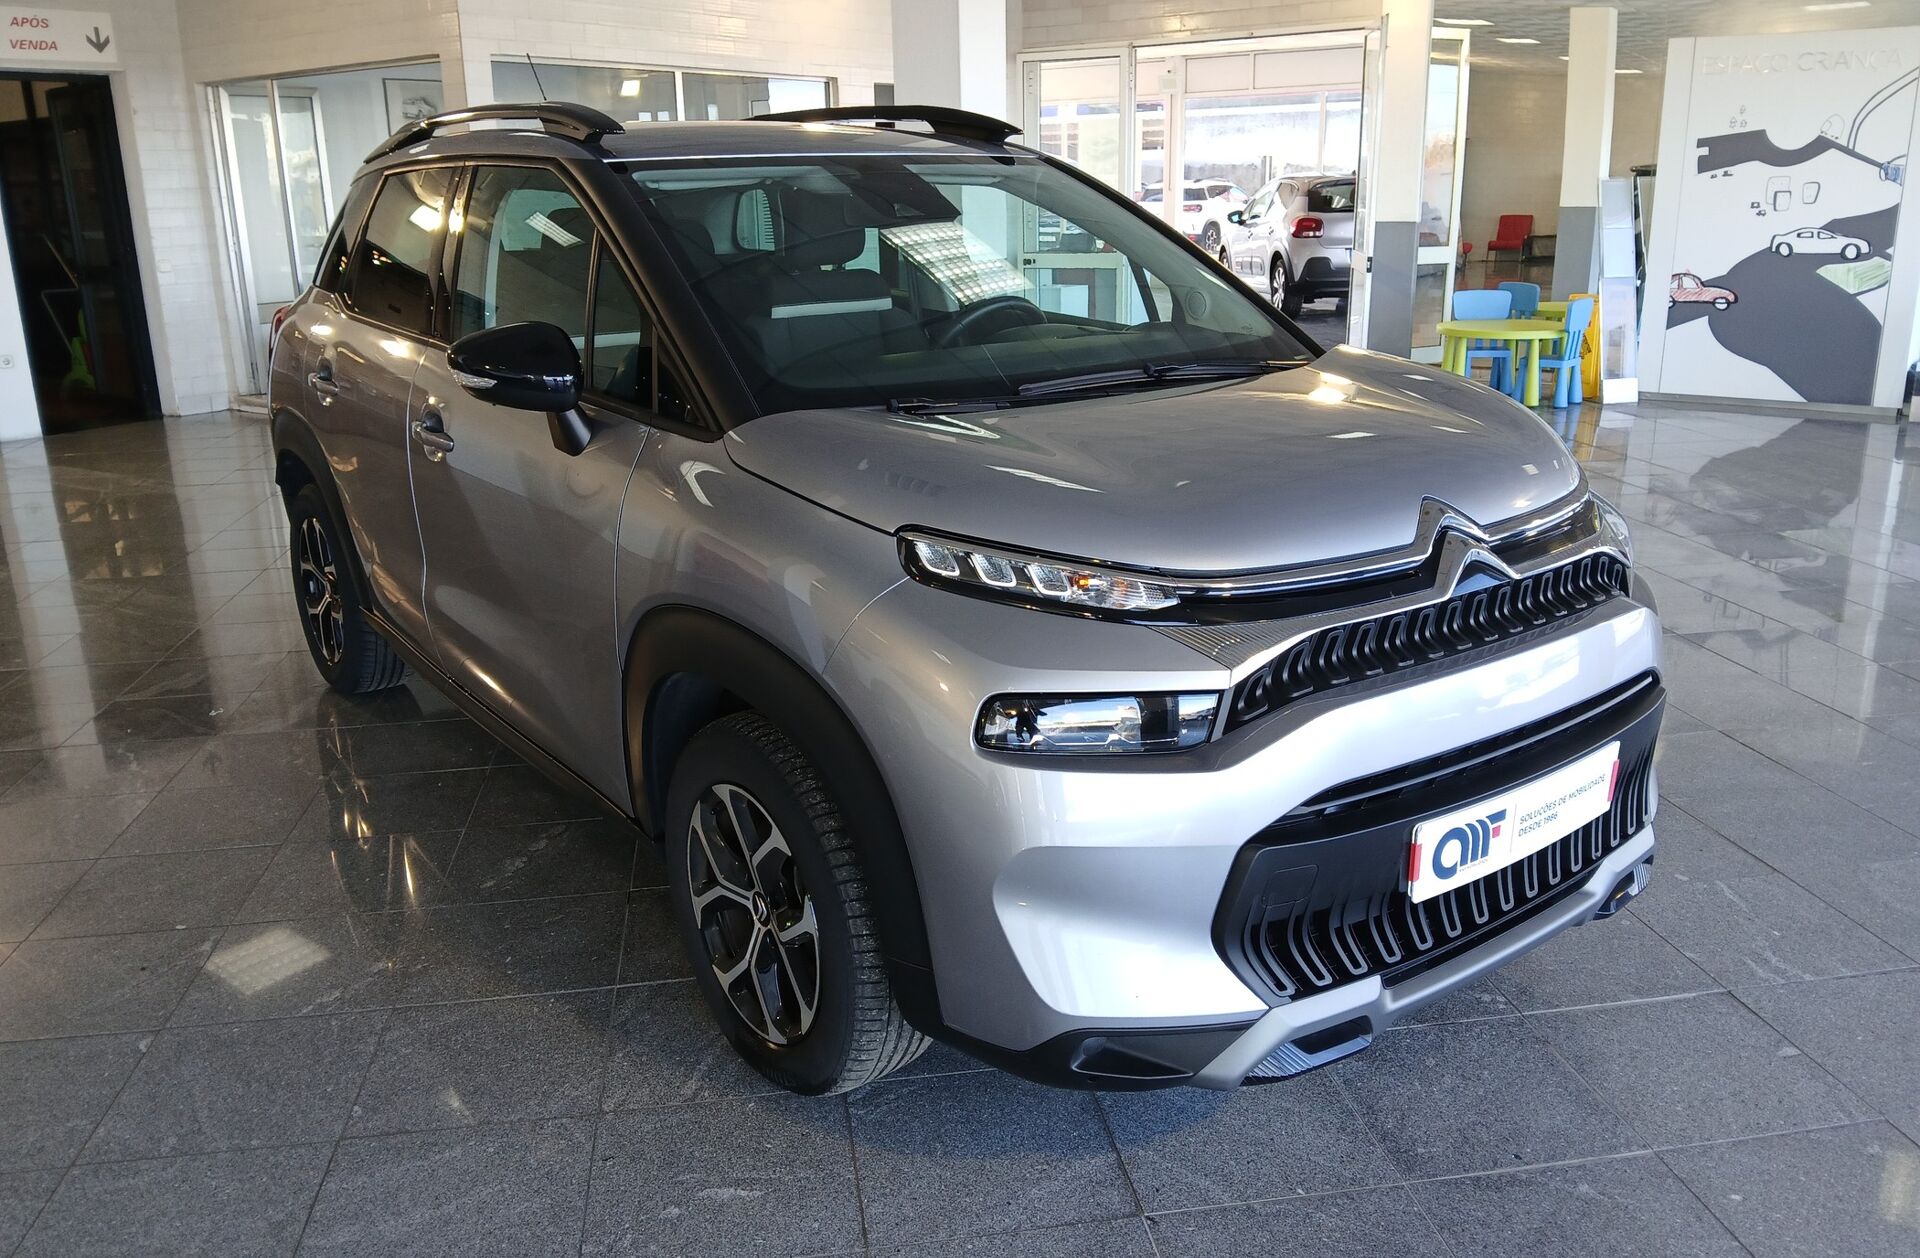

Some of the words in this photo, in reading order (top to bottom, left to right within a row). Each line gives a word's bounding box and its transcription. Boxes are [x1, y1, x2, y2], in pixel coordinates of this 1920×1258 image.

[10, 14, 49, 29] APÓS
[9, 39, 58, 51] VENDA
[1519, 801, 1557, 825] SOLUÇÕES
[1558, 795, 1568, 806] DE
[1568, 773, 1606, 801] MOBILIDADE
[1518, 820, 1543, 837] DESDE
